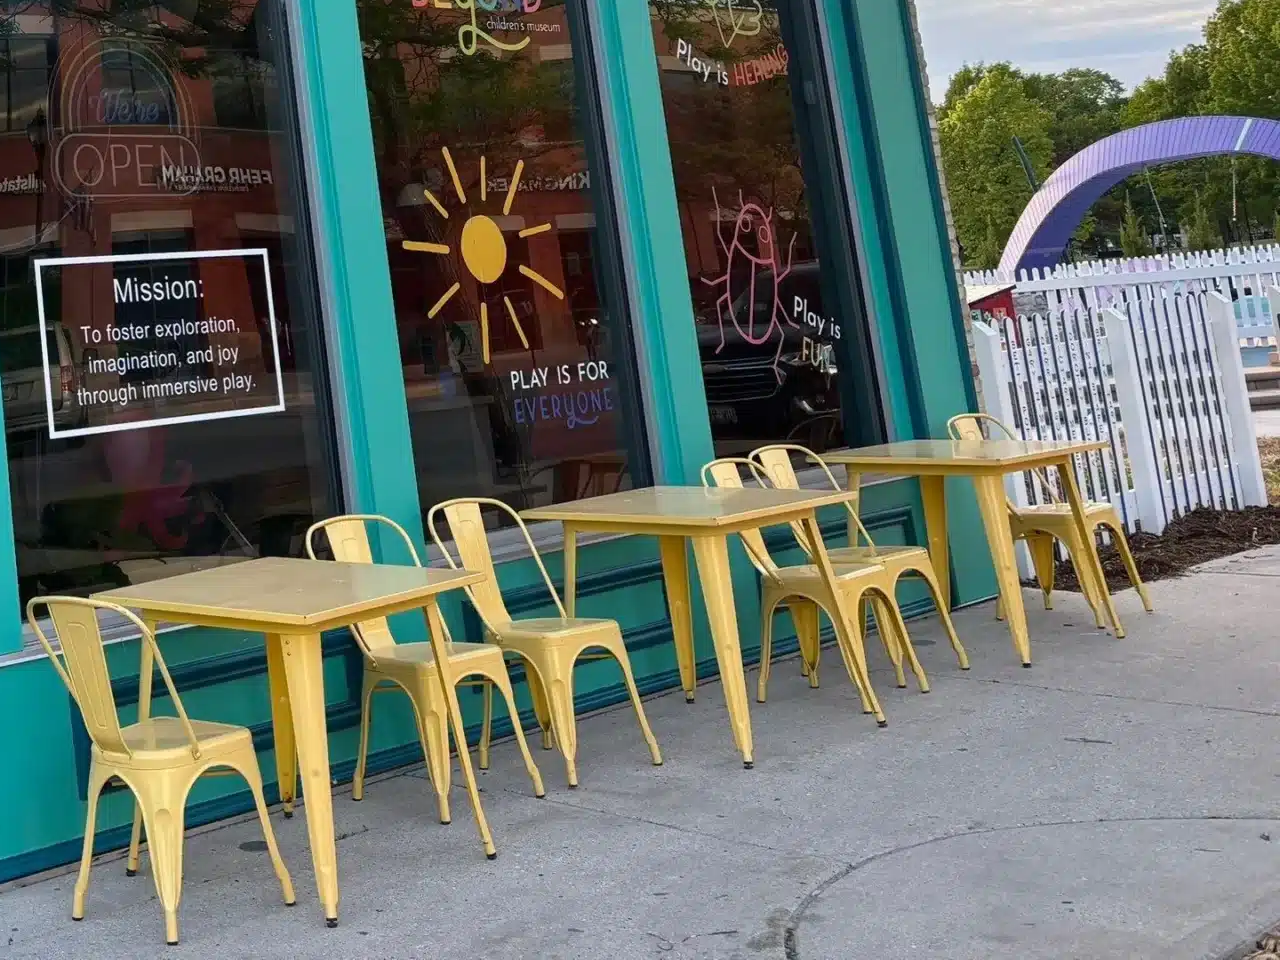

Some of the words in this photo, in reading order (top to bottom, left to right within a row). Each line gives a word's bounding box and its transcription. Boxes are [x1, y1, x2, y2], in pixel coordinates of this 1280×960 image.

[486, 15, 525, 32] children's
[526, 21, 561, 32] museum
[676, 37, 712, 83] Play
[716, 62, 729, 86] is
[733, 42, 790, 87] HEALING
[73, 143, 186, 189] OPEN
[112, 275, 204, 304] Mission:
[80, 325, 102, 344] To
[106, 323, 151, 342] foster
[154, 316, 241, 340] exploration,
[793, 295, 826, 336] Play
[830, 317, 841, 340] is
[88, 350, 182, 376] imagination,
[186, 345, 214, 365] and
[218, 344, 239, 366] joy
[802, 336, 832, 373] FUN
[77, 382, 138, 406] through
[141, 375, 219, 399] immersive
[222, 373, 257, 395] play.
[510, 366, 549, 391] PLAY
[556, 364, 571, 385] IS
[577, 360, 609, 382] FOR
[513, 387, 613, 429] EVERYONE
